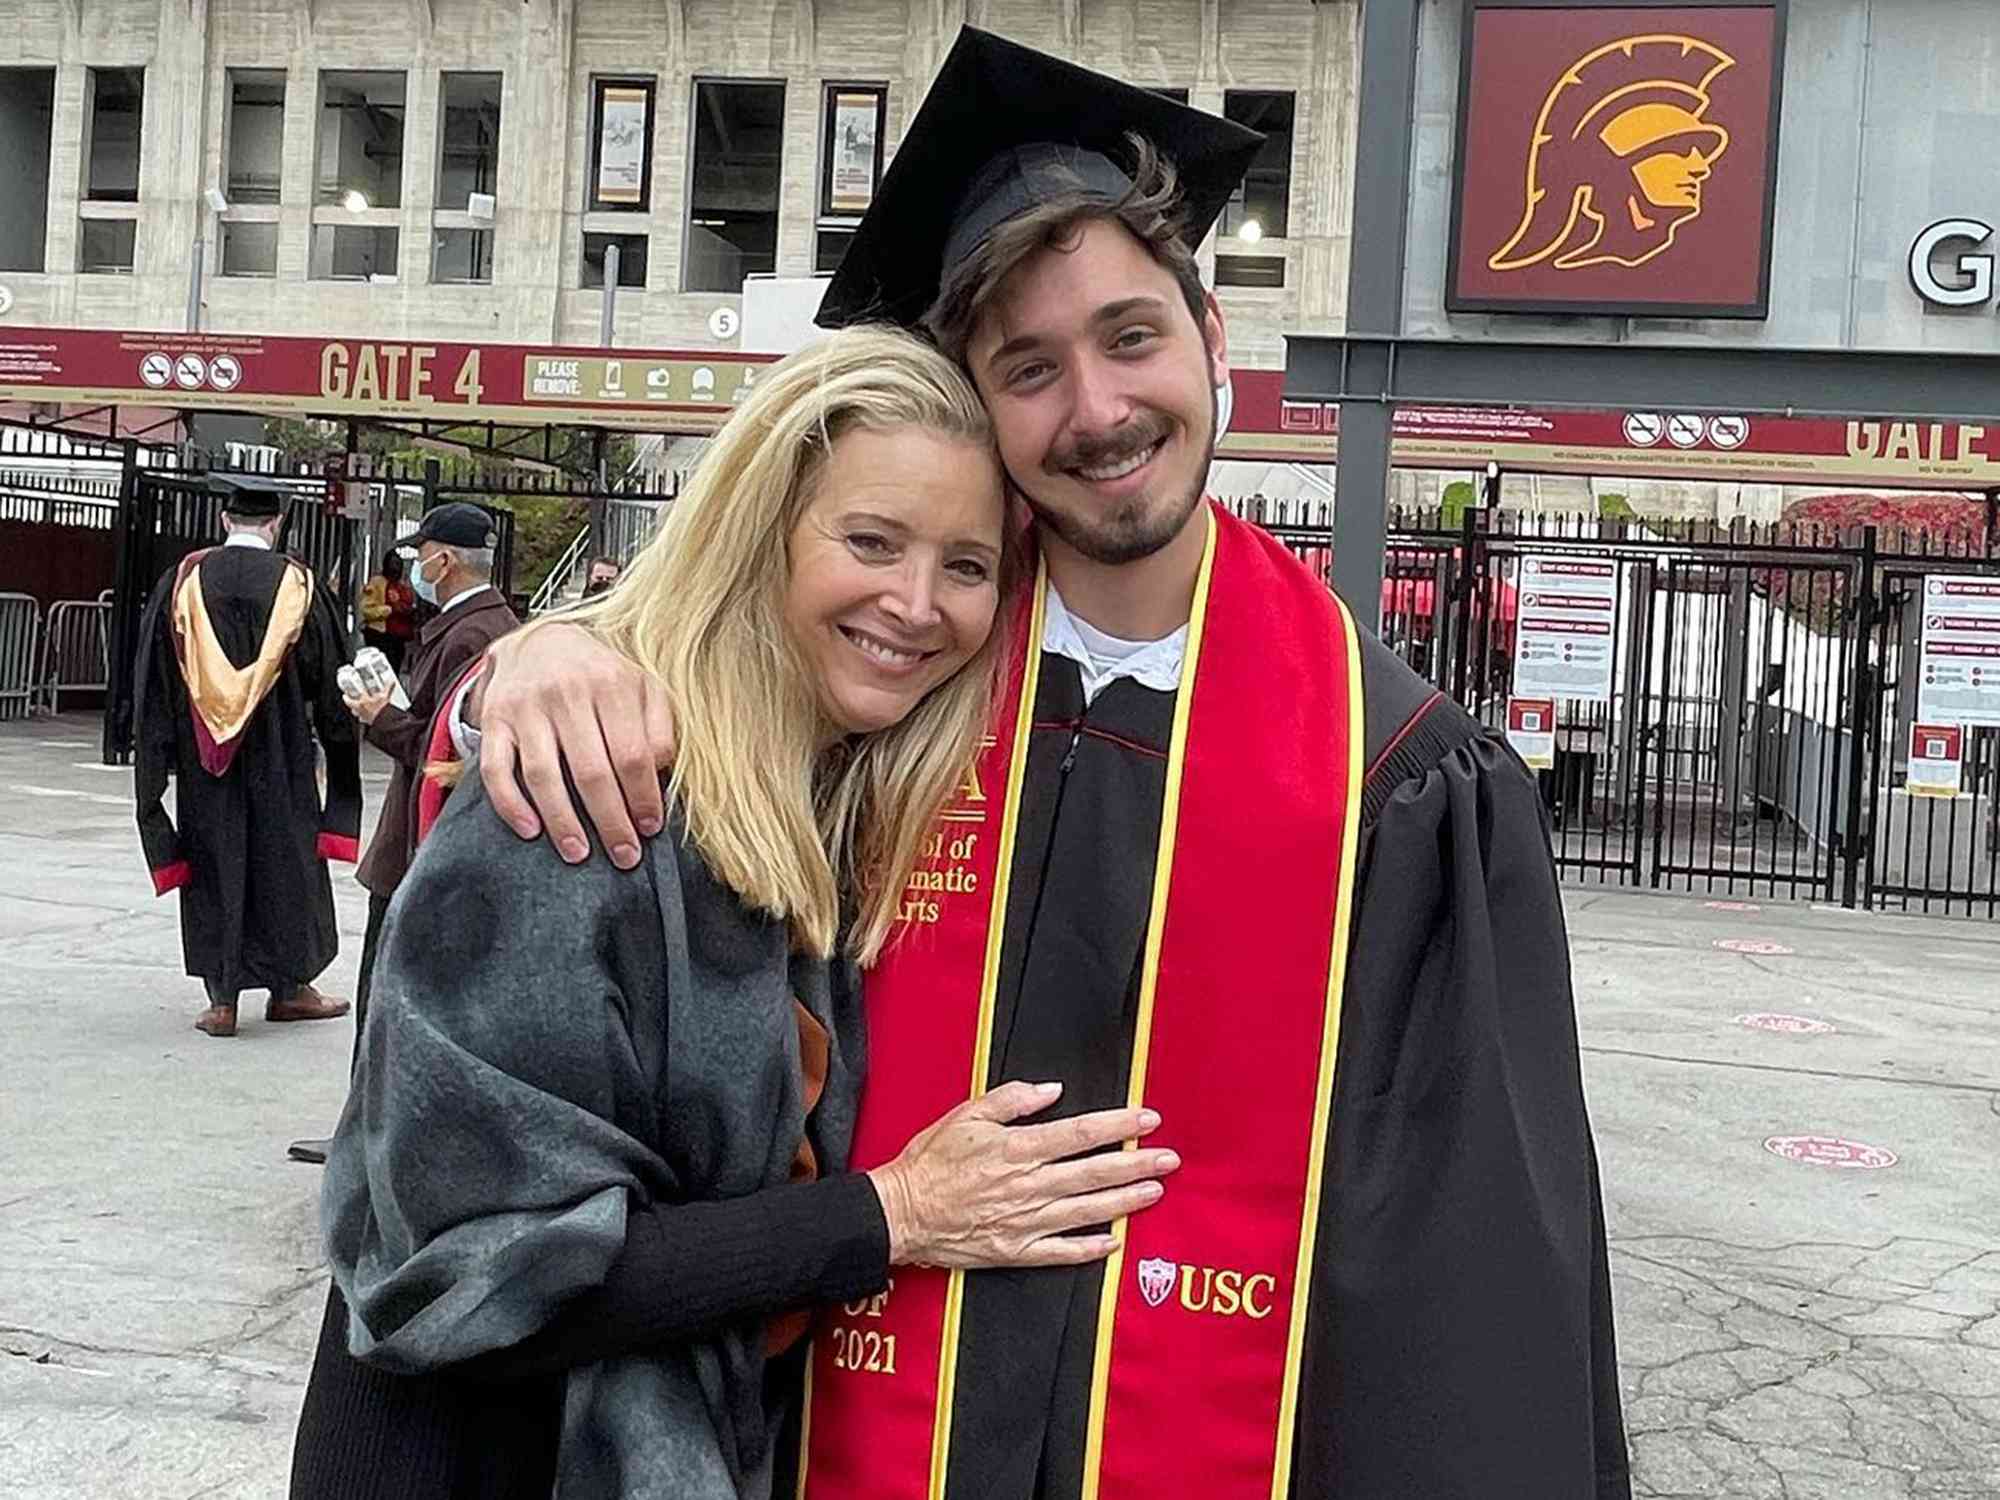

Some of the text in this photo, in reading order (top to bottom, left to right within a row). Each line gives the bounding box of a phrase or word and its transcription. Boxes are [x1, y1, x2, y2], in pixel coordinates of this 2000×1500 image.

[1909, 218, 2000, 308] G
[719, 314, 729, 332] 5
[320, 342, 485, 406] GATE 4
[533, 378, 582, 396] REMOVE:
[538, 360, 580, 378] PLEASE
[949, 834, 977, 860] of
[1179, 1264, 1276, 1319] USC
[832, 1327, 896, 1375] 2021
